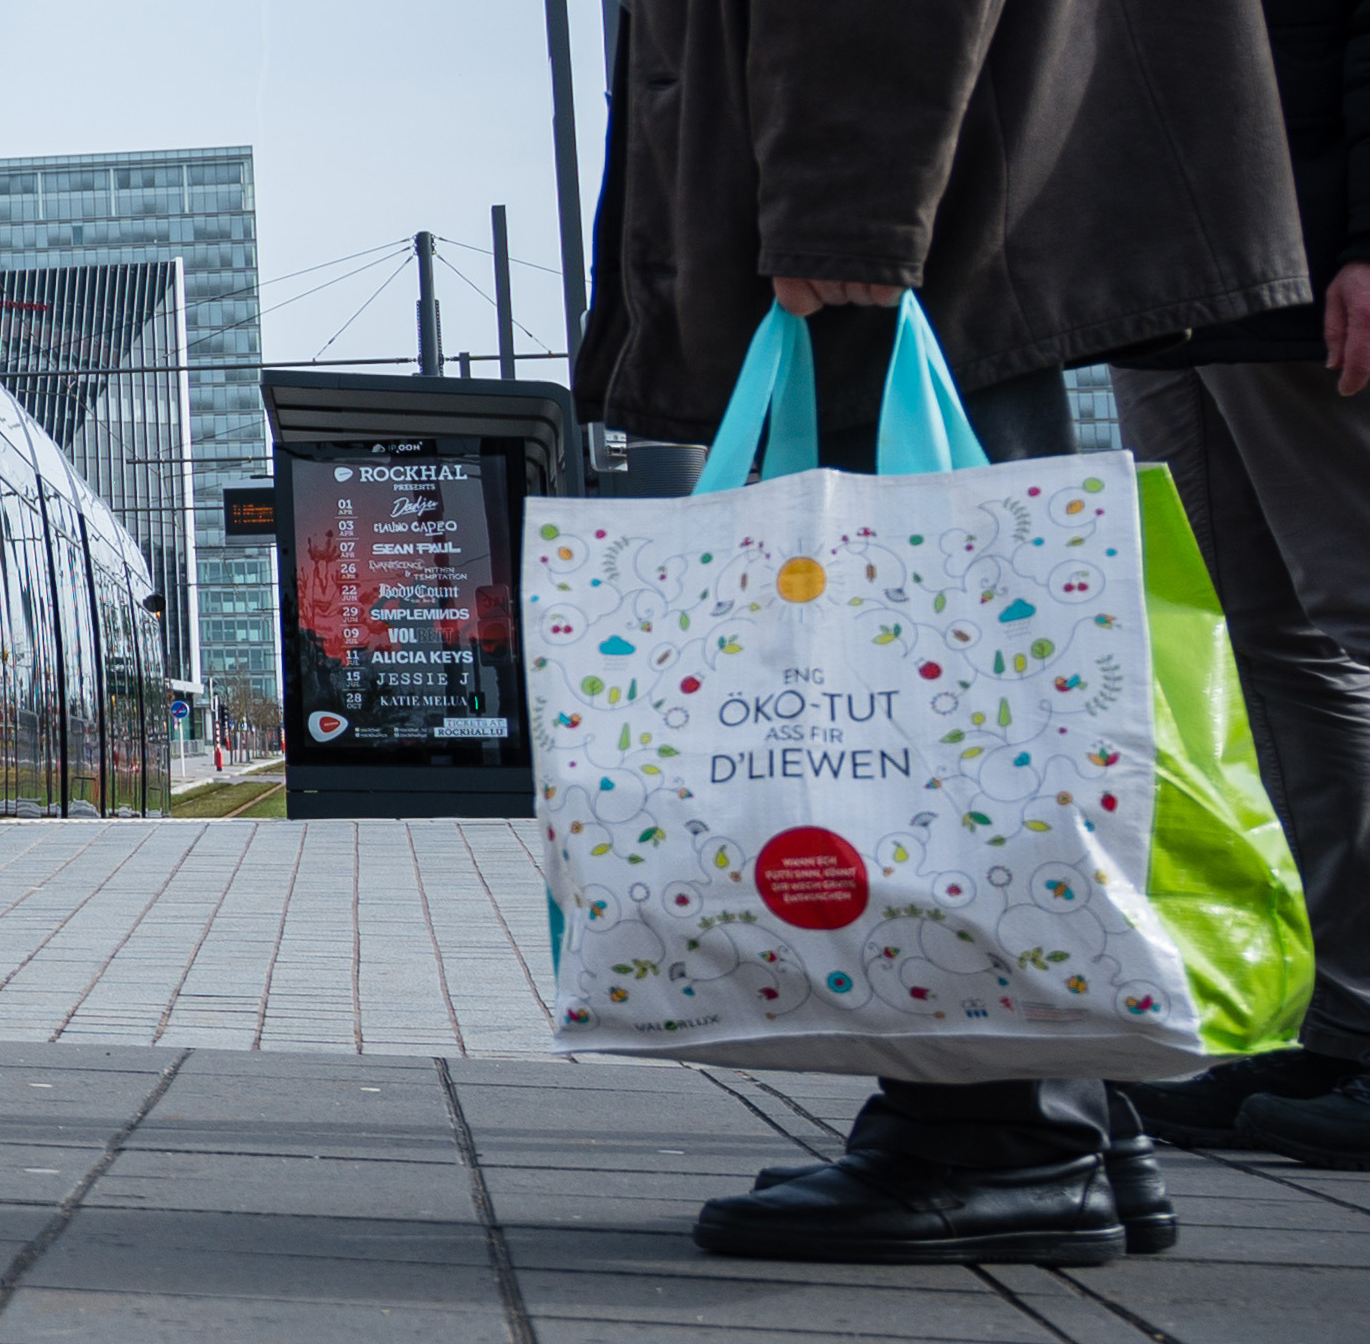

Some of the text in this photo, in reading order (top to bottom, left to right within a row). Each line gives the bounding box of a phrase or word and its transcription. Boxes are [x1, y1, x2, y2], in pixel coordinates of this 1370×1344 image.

[359, 465, 468, 482] ROCKHAL
[338, 499, 353, 509] 01
[338, 520, 354, 531] 03
[339, 542, 355, 552] 07
[372, 542, 461, 555] SEAN PAUL
[340, 563, 356, 573] 26
[341, 585, 357, 595] 22
[342, 607, 359, 617] 29
[343, 628, 360, 638] 09
[346, 650, 359, 660] 11
[371, 650, 474, 664] ALICIA KEYS
[346, 671, 361, 681] 15
[376, 672, 470, 685] JESSIE J
[783, 667, 825, 685] ENG
[346, 693, 362, 703] 28
[380, 695, 468, 706] KATIE MELUA
[718, 689, 900, 727] ÖKO-TUT
[764, 725, 844, 744] ASS FIR
[710, 747, 911, 784] D'LIEWEN
